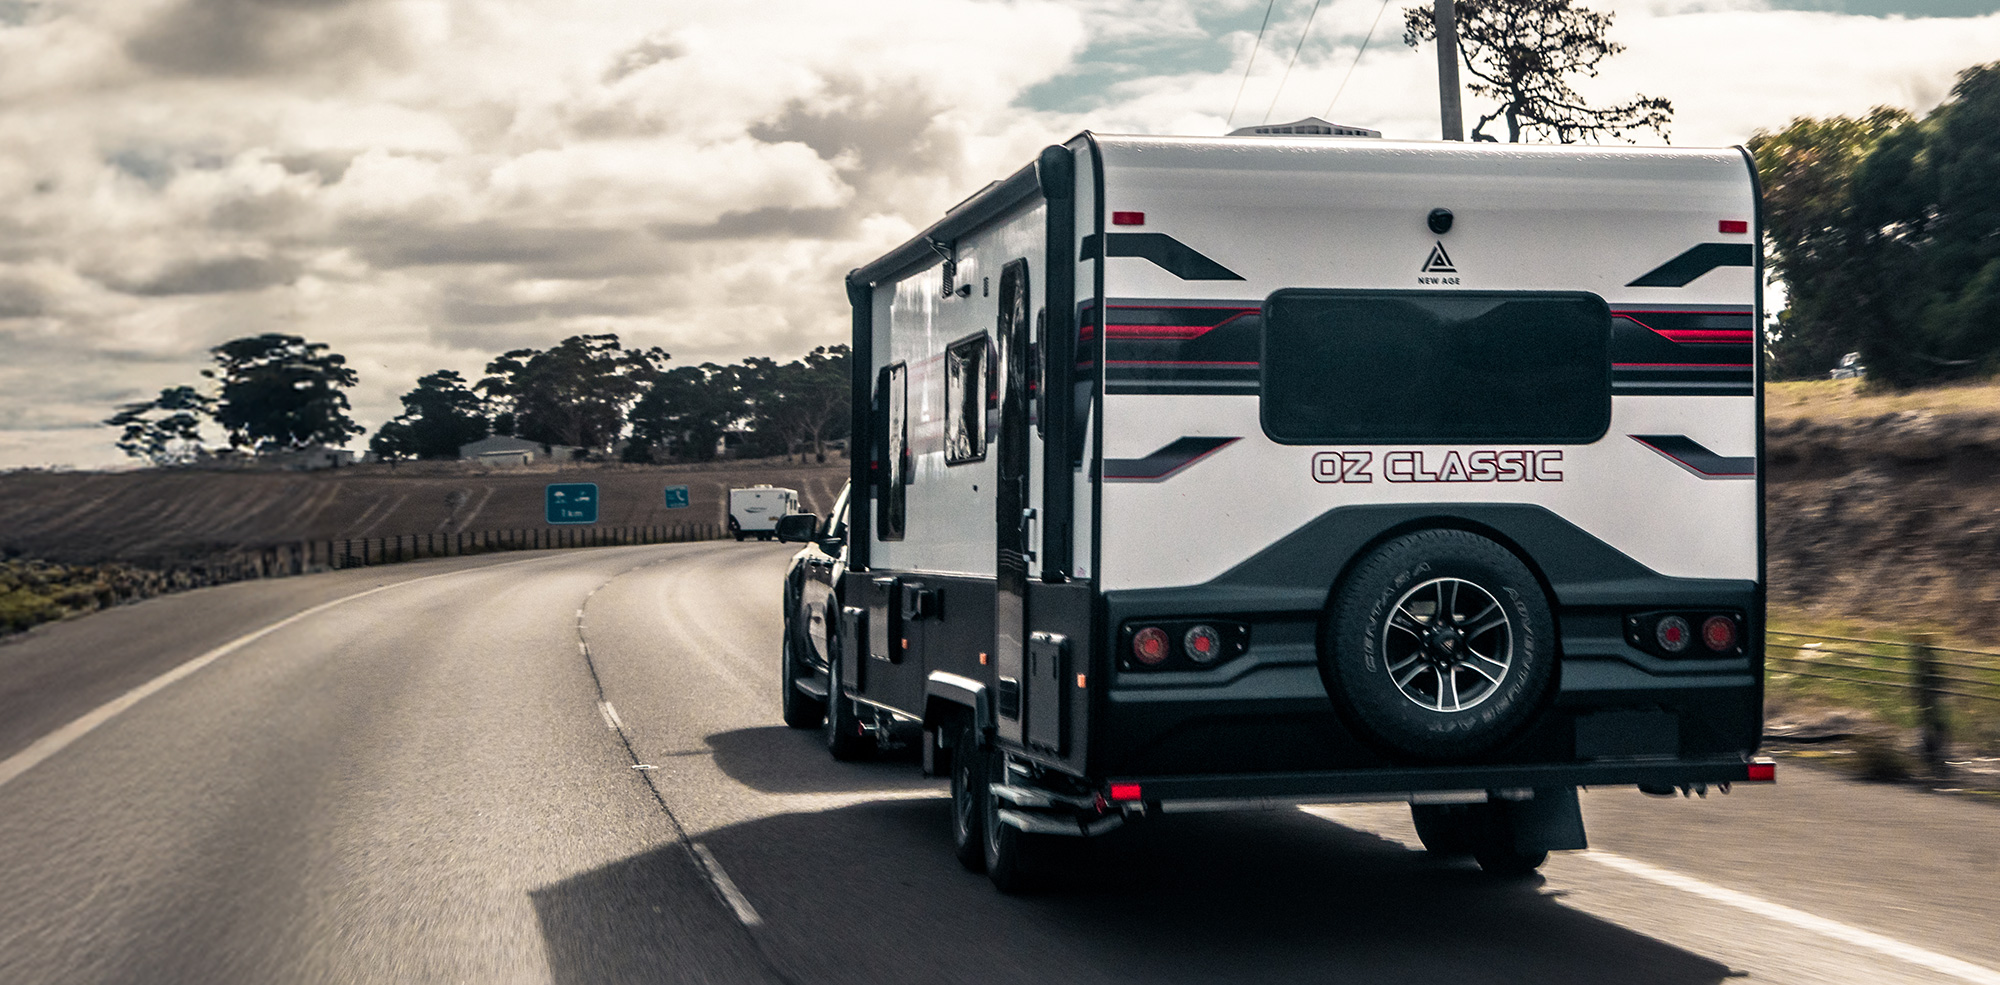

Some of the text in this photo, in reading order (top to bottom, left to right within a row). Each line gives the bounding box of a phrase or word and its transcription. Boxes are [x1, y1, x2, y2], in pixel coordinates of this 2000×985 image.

[1418, 277, 1460, 285] NEW AGE
[1312, 450, 1564, 483] OZ CLASSIC
